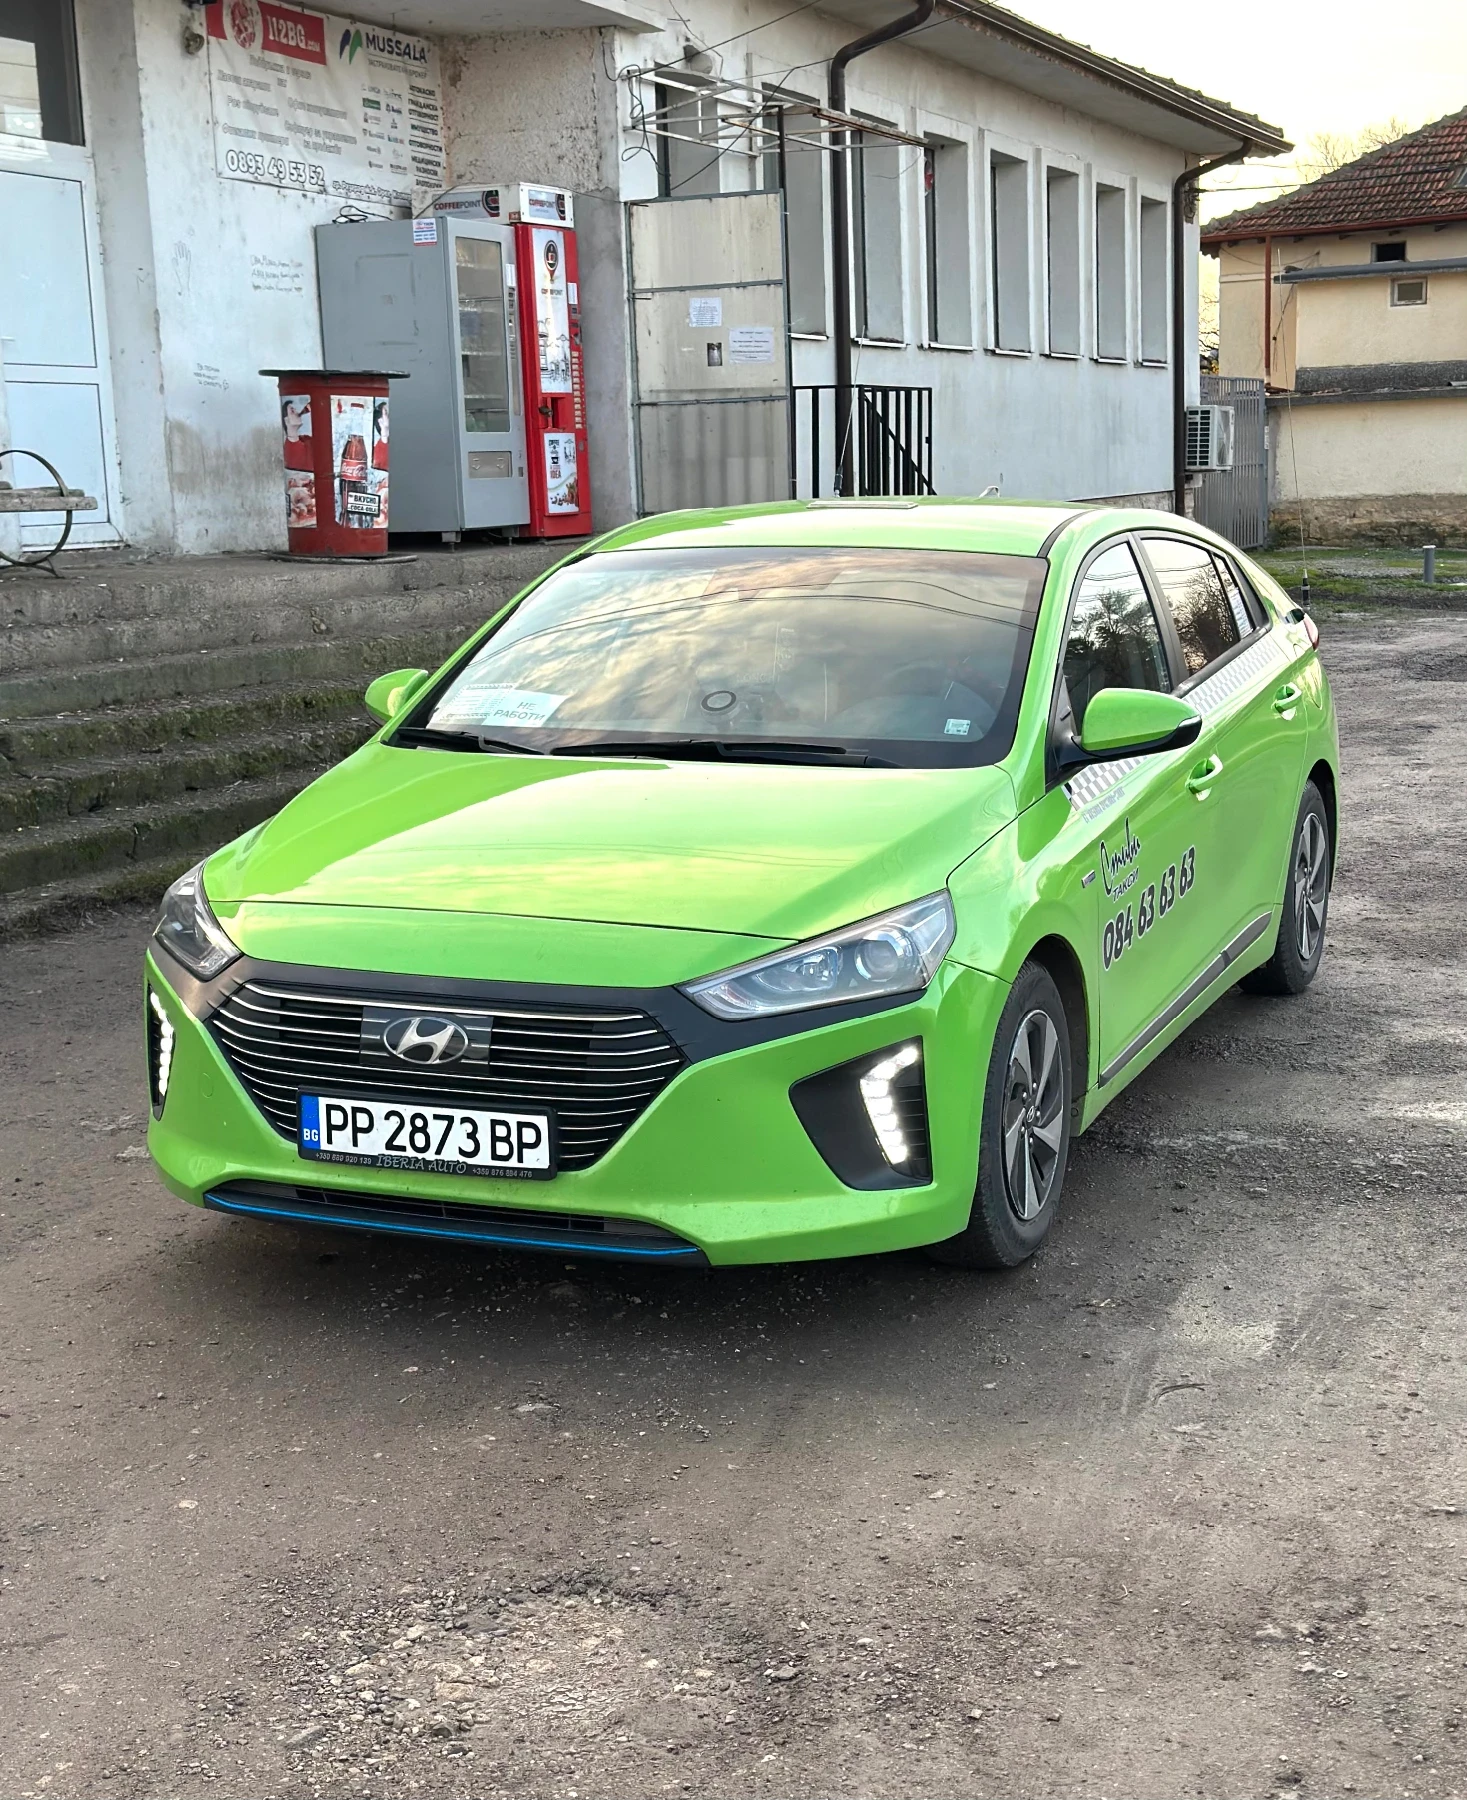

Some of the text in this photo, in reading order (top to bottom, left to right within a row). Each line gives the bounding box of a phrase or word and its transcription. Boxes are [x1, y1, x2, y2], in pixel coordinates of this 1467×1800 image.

[366, 32, 428, 63] MUSSALA
[226, 149, 325, 187] 0893 49 53 52
[434, 200, 482, 212] COFFEEPOINT
[493, 710, 546, 721] РАБОТИ
[516, 701, 537, 710] НЕ
[1112, 865, 1140, 903] ТАКСИ
[1102, 844, 1196, 971] 084 63 63 63
[303, 1128, 319, 1142] BG
[325, 1103, 542, 1163] PP 2873 BP
[376, 1154, 467, 1174] IBERIA AUTO
